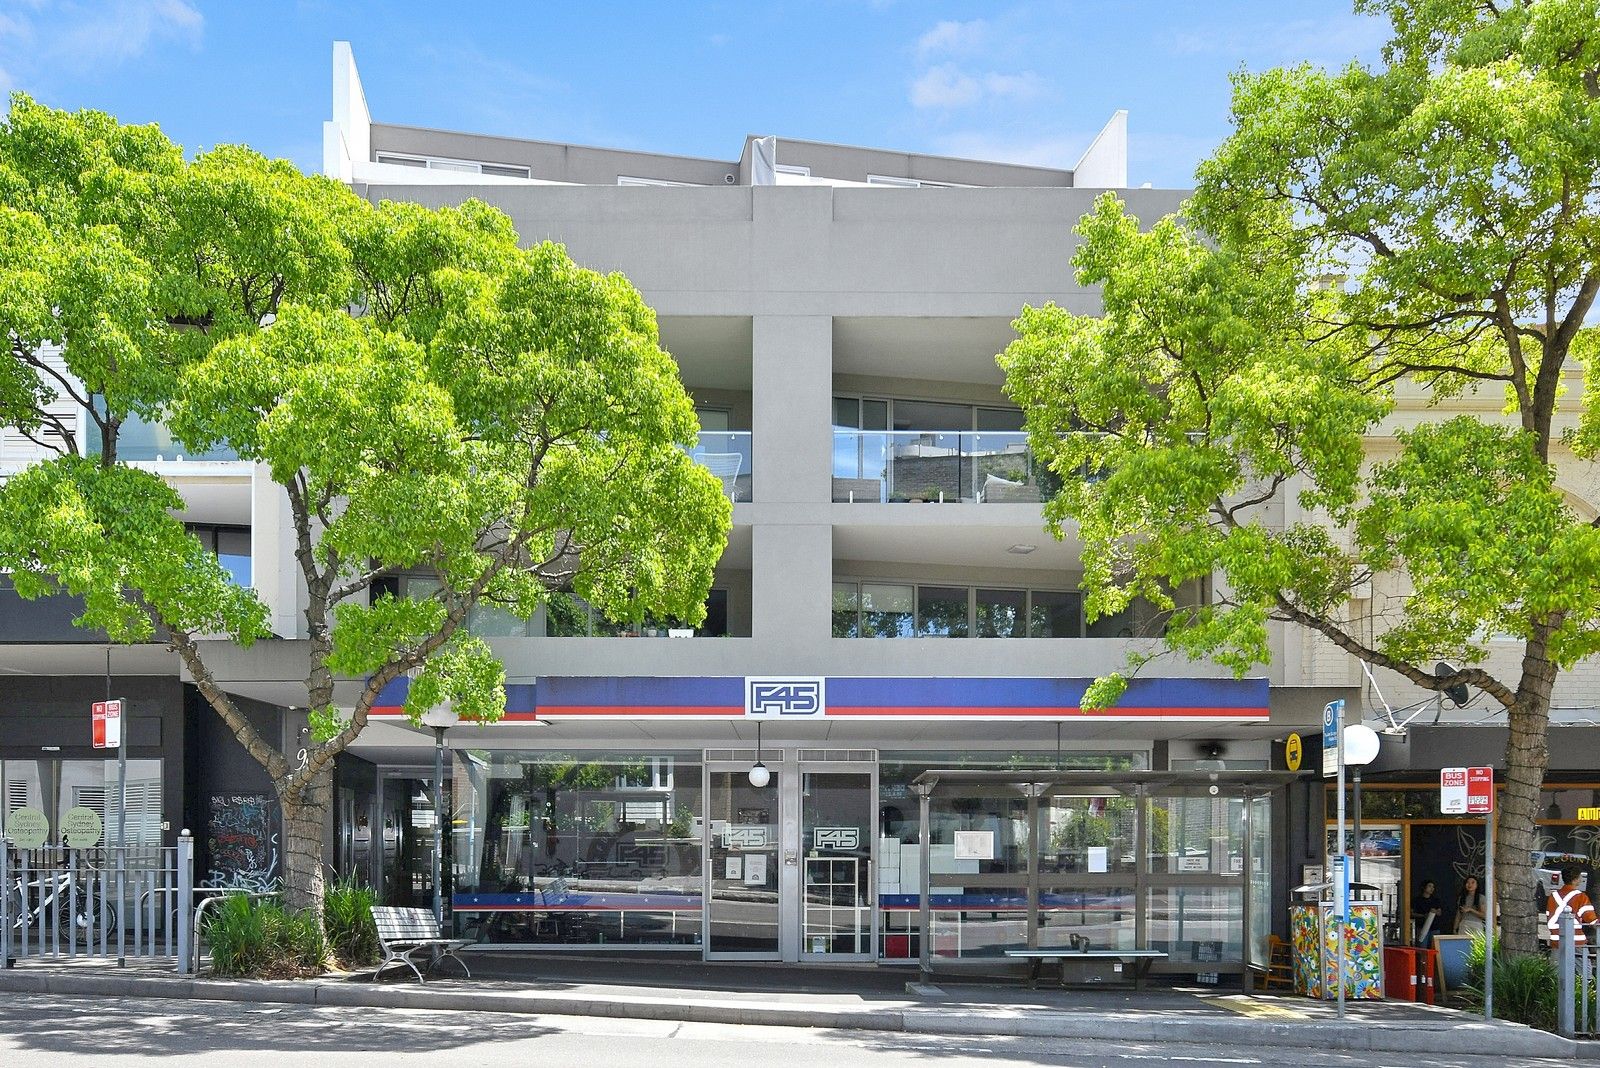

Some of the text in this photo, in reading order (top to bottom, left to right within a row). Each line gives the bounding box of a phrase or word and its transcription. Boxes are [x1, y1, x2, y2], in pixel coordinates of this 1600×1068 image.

[753, 684, 816, 711] F45
[1445, 772, 1463, 780] BUS
[15, 813, 41, 821] Central
[68, 813, 94, 821] Central
[723, 828, 766, 847] F45
[815, 828, 858, 848] F45
